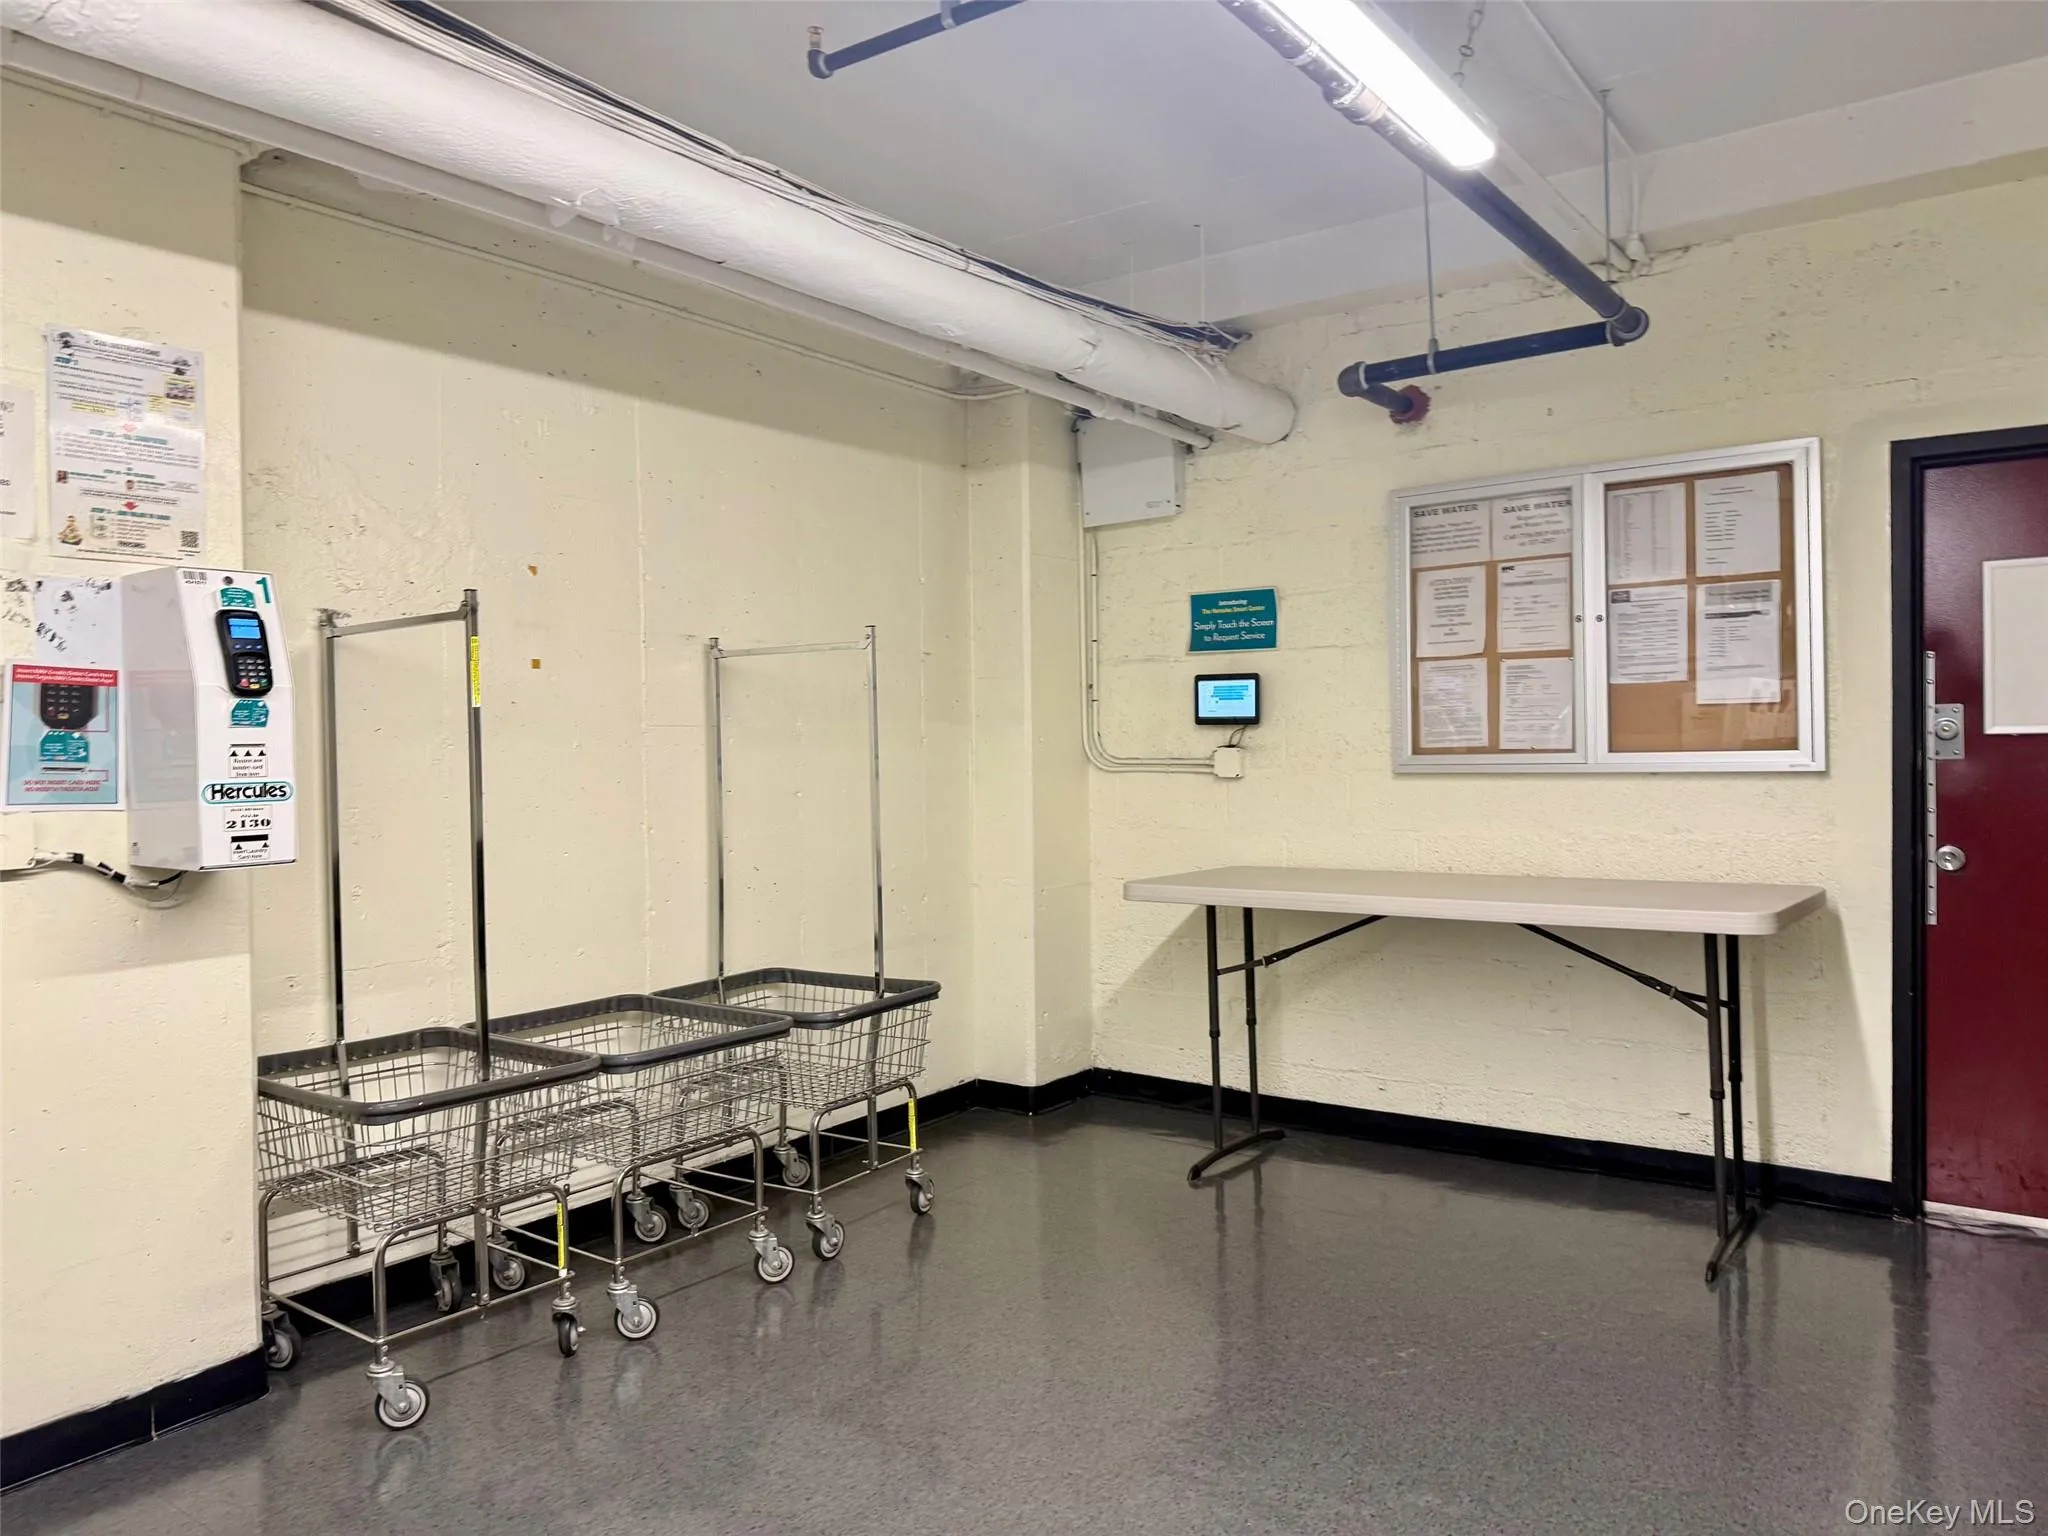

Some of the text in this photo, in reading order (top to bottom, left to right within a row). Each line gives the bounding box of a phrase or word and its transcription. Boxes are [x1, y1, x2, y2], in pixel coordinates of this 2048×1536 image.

[1413, 503, 1479, 518] SAVE WATER
[1503, 499, 1572, 514] SAVE WATER
[256, 577, 271, 604] 1
[1193, 618, 1274, 631] Simply Touch the Screen
[1212, 632, 1240, 643] Request
[1241, 631, 1266, 640] Service
[210, 783, 287, 800] Hercules
[225, 818, 272, 830] 2130
